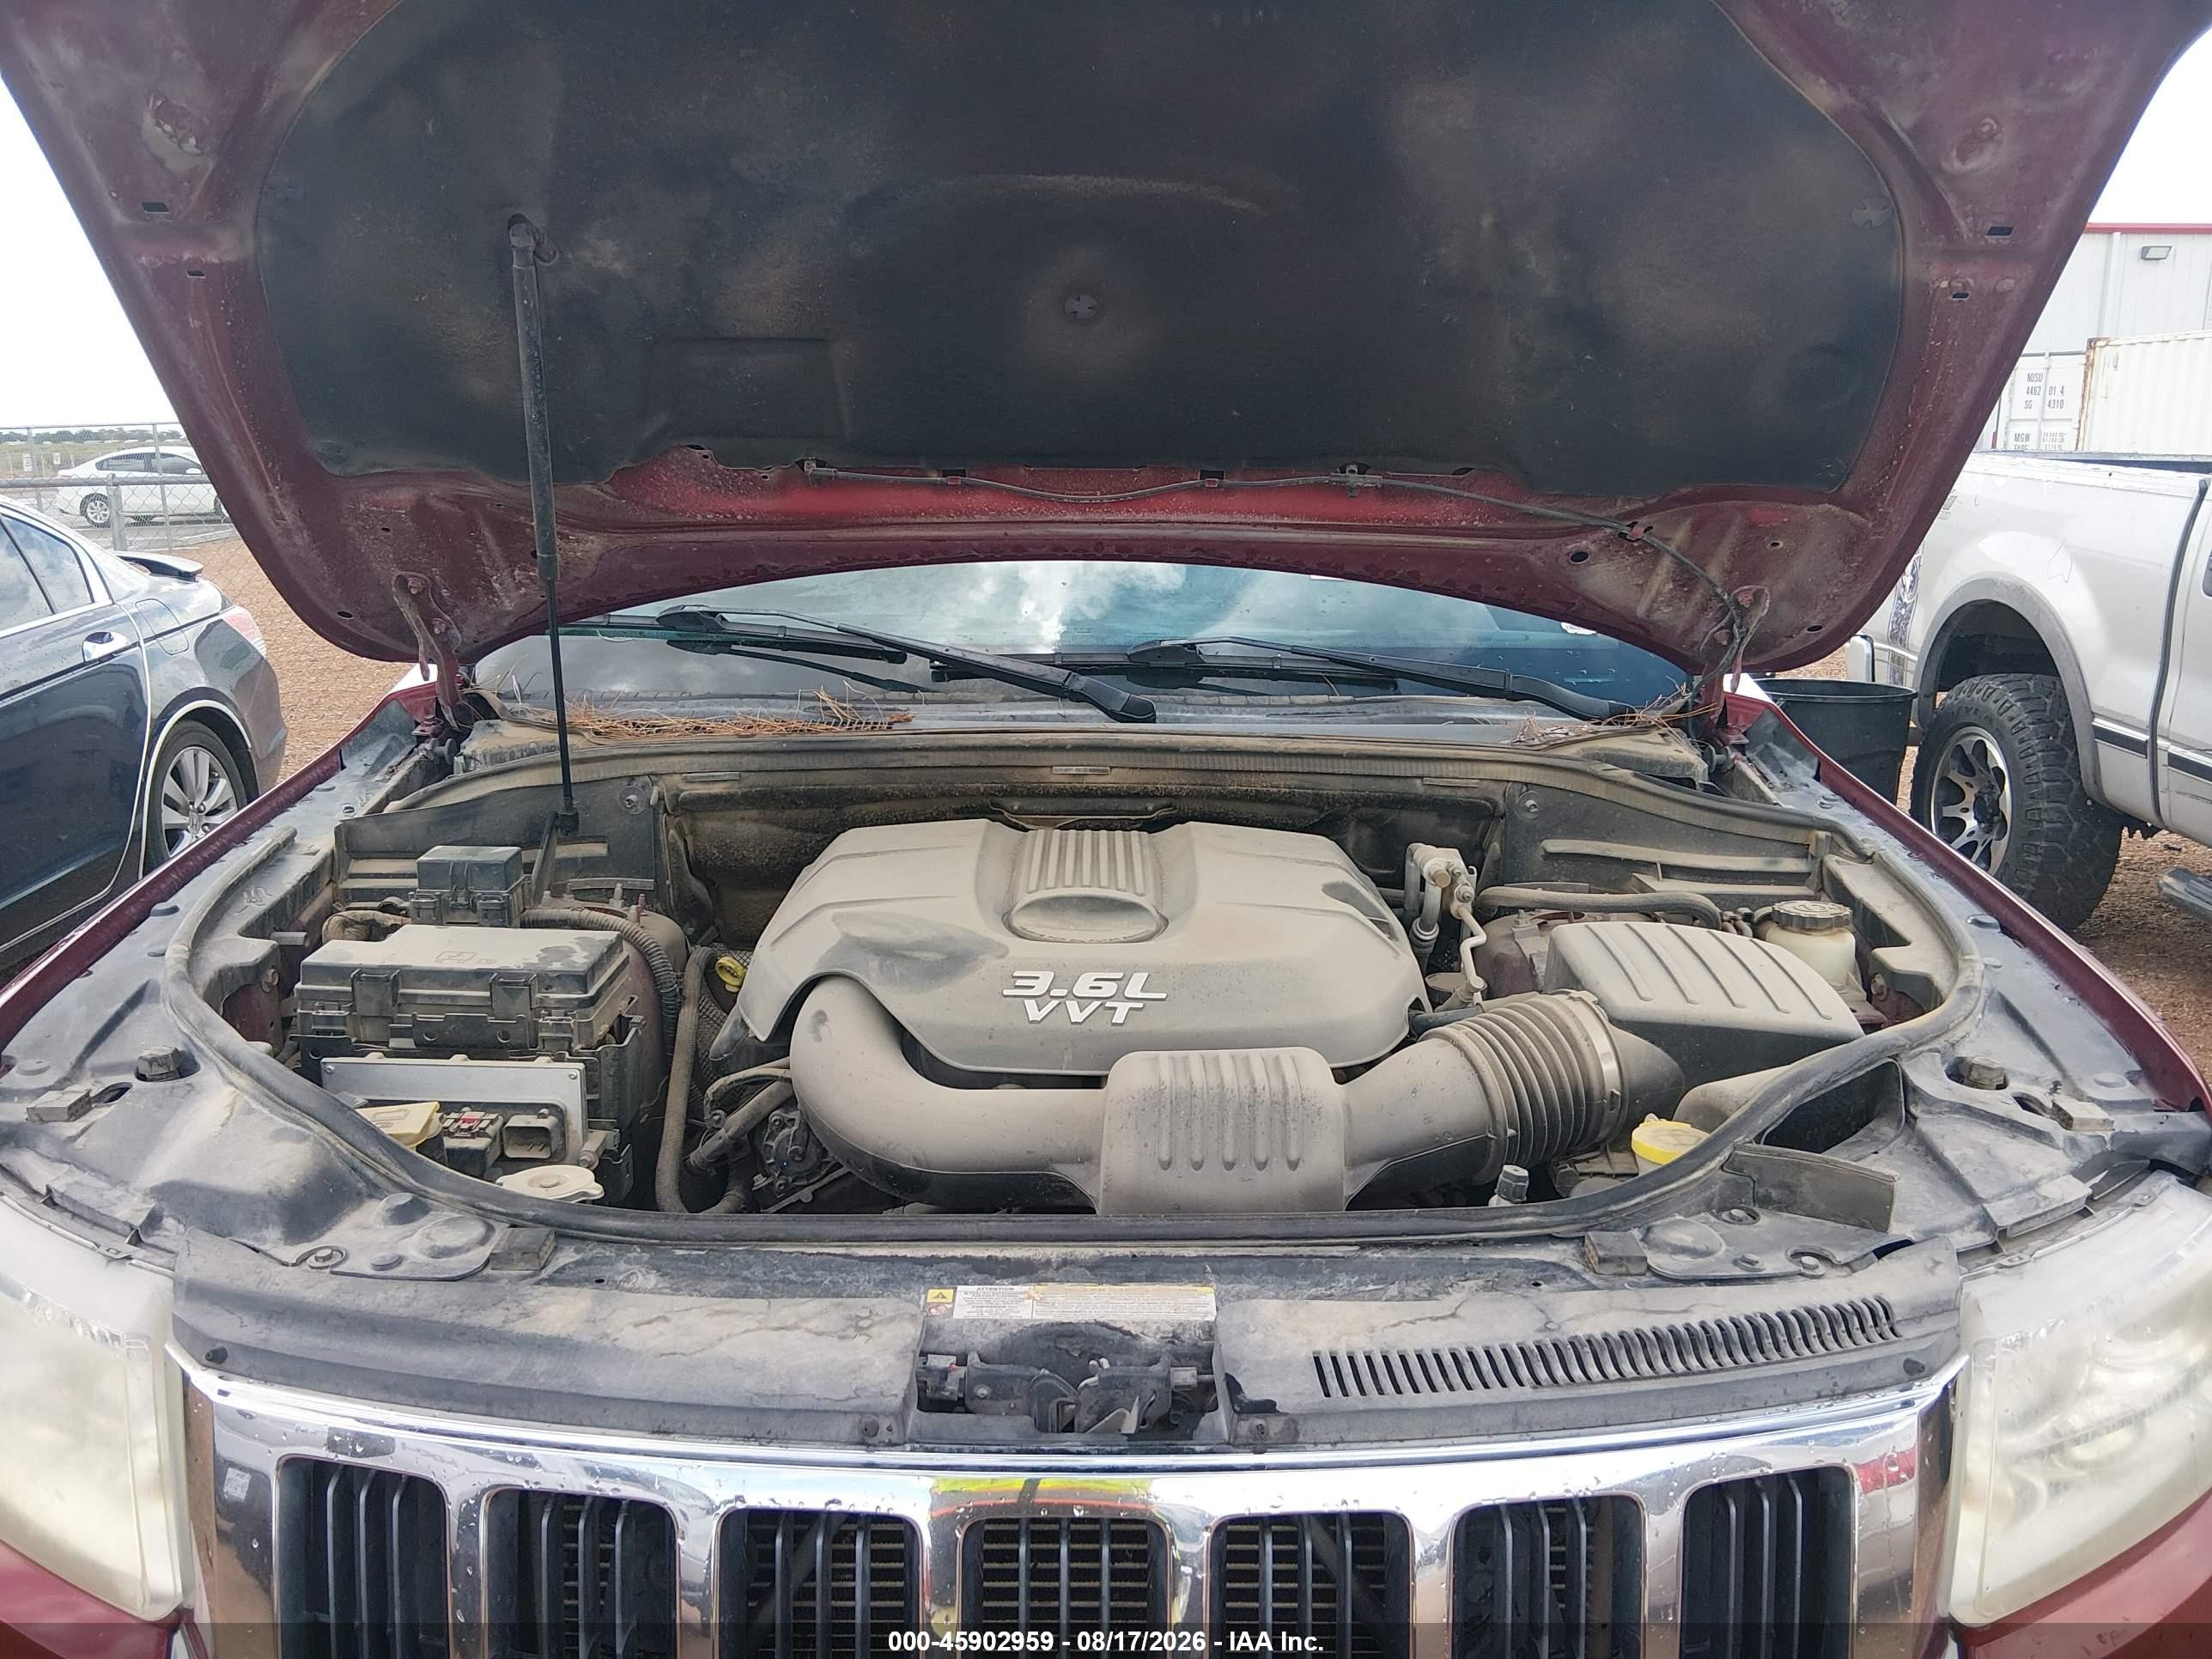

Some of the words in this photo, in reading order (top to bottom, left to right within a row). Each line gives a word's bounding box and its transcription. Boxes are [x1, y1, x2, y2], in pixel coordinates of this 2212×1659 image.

[2027, 373, 2043, 382] NOSU
[2026, 386, 2041, 395] 4462
[2048, 386, 2056, 395] 01
[2060, 385, 2064, 396] 4
[2047, 398, 2064, 410] 4310
[2014, 433, 2031, 442] MGW
[1002, 970, 1169, 1000] 3.6L
[1023, 999, 1145, 1026] VVT
